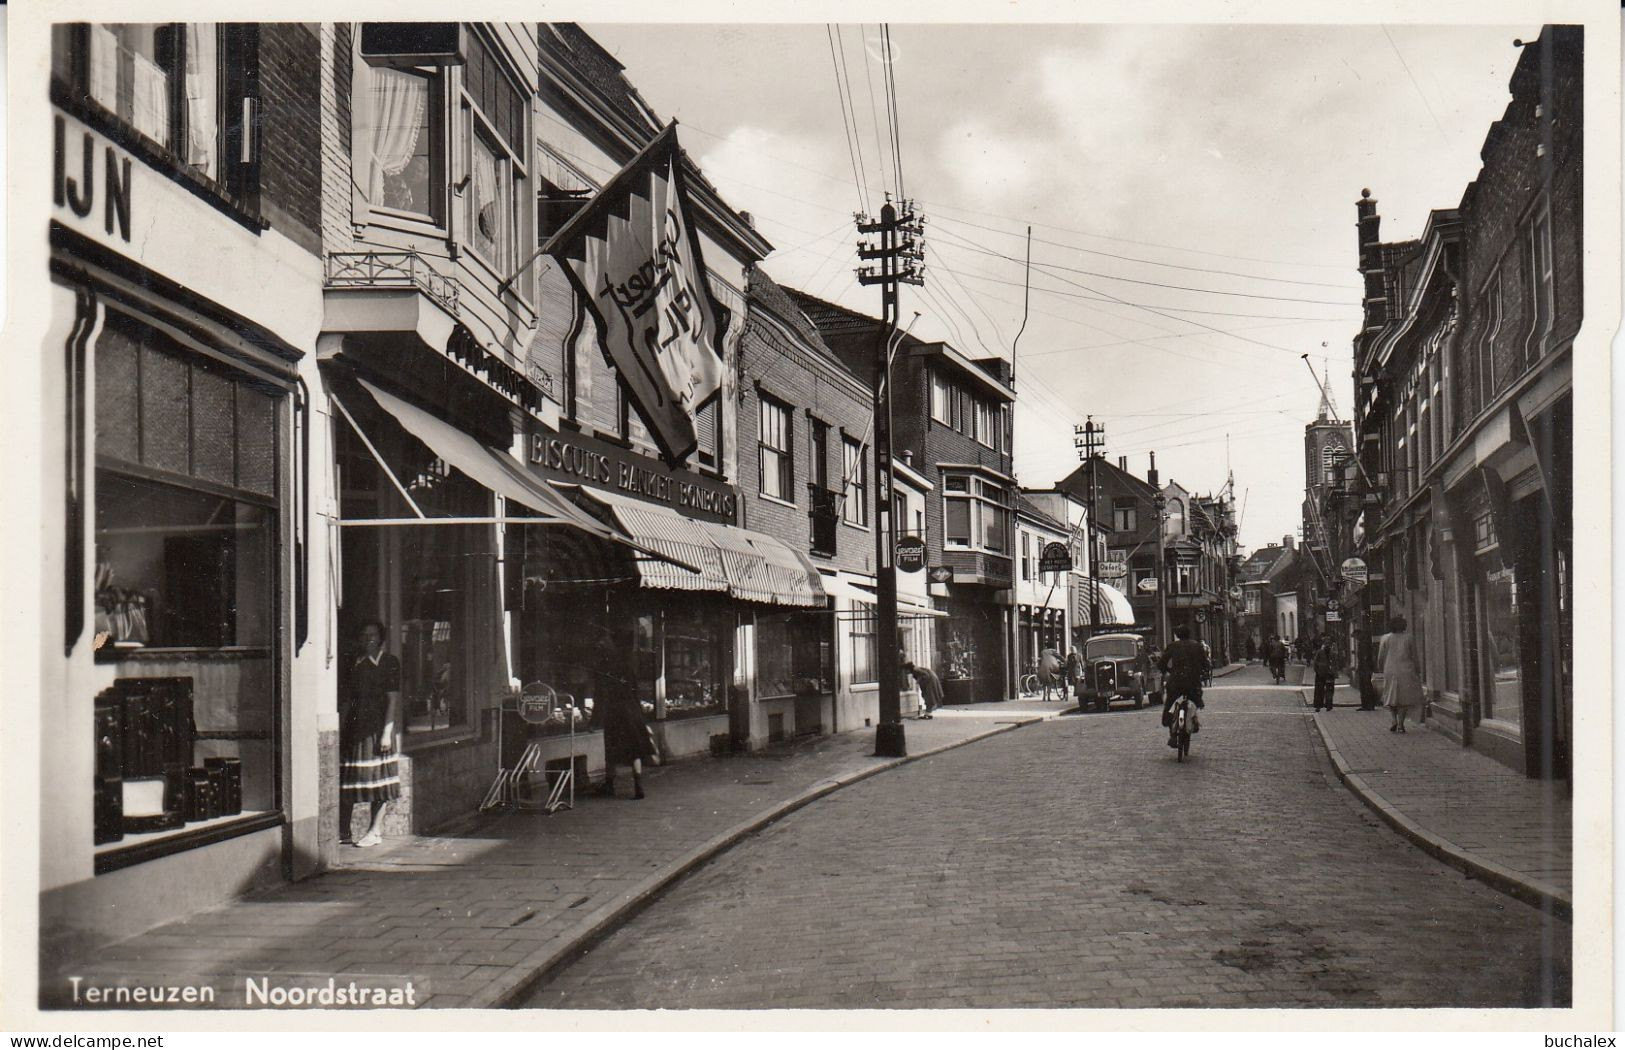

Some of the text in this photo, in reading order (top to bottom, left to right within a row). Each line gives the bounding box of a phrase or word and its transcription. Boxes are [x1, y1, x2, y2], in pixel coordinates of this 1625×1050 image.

[54, 114, 132, 243] IJN
[530, 432, 733, 517] BISCUITS BANKET BONBONS
